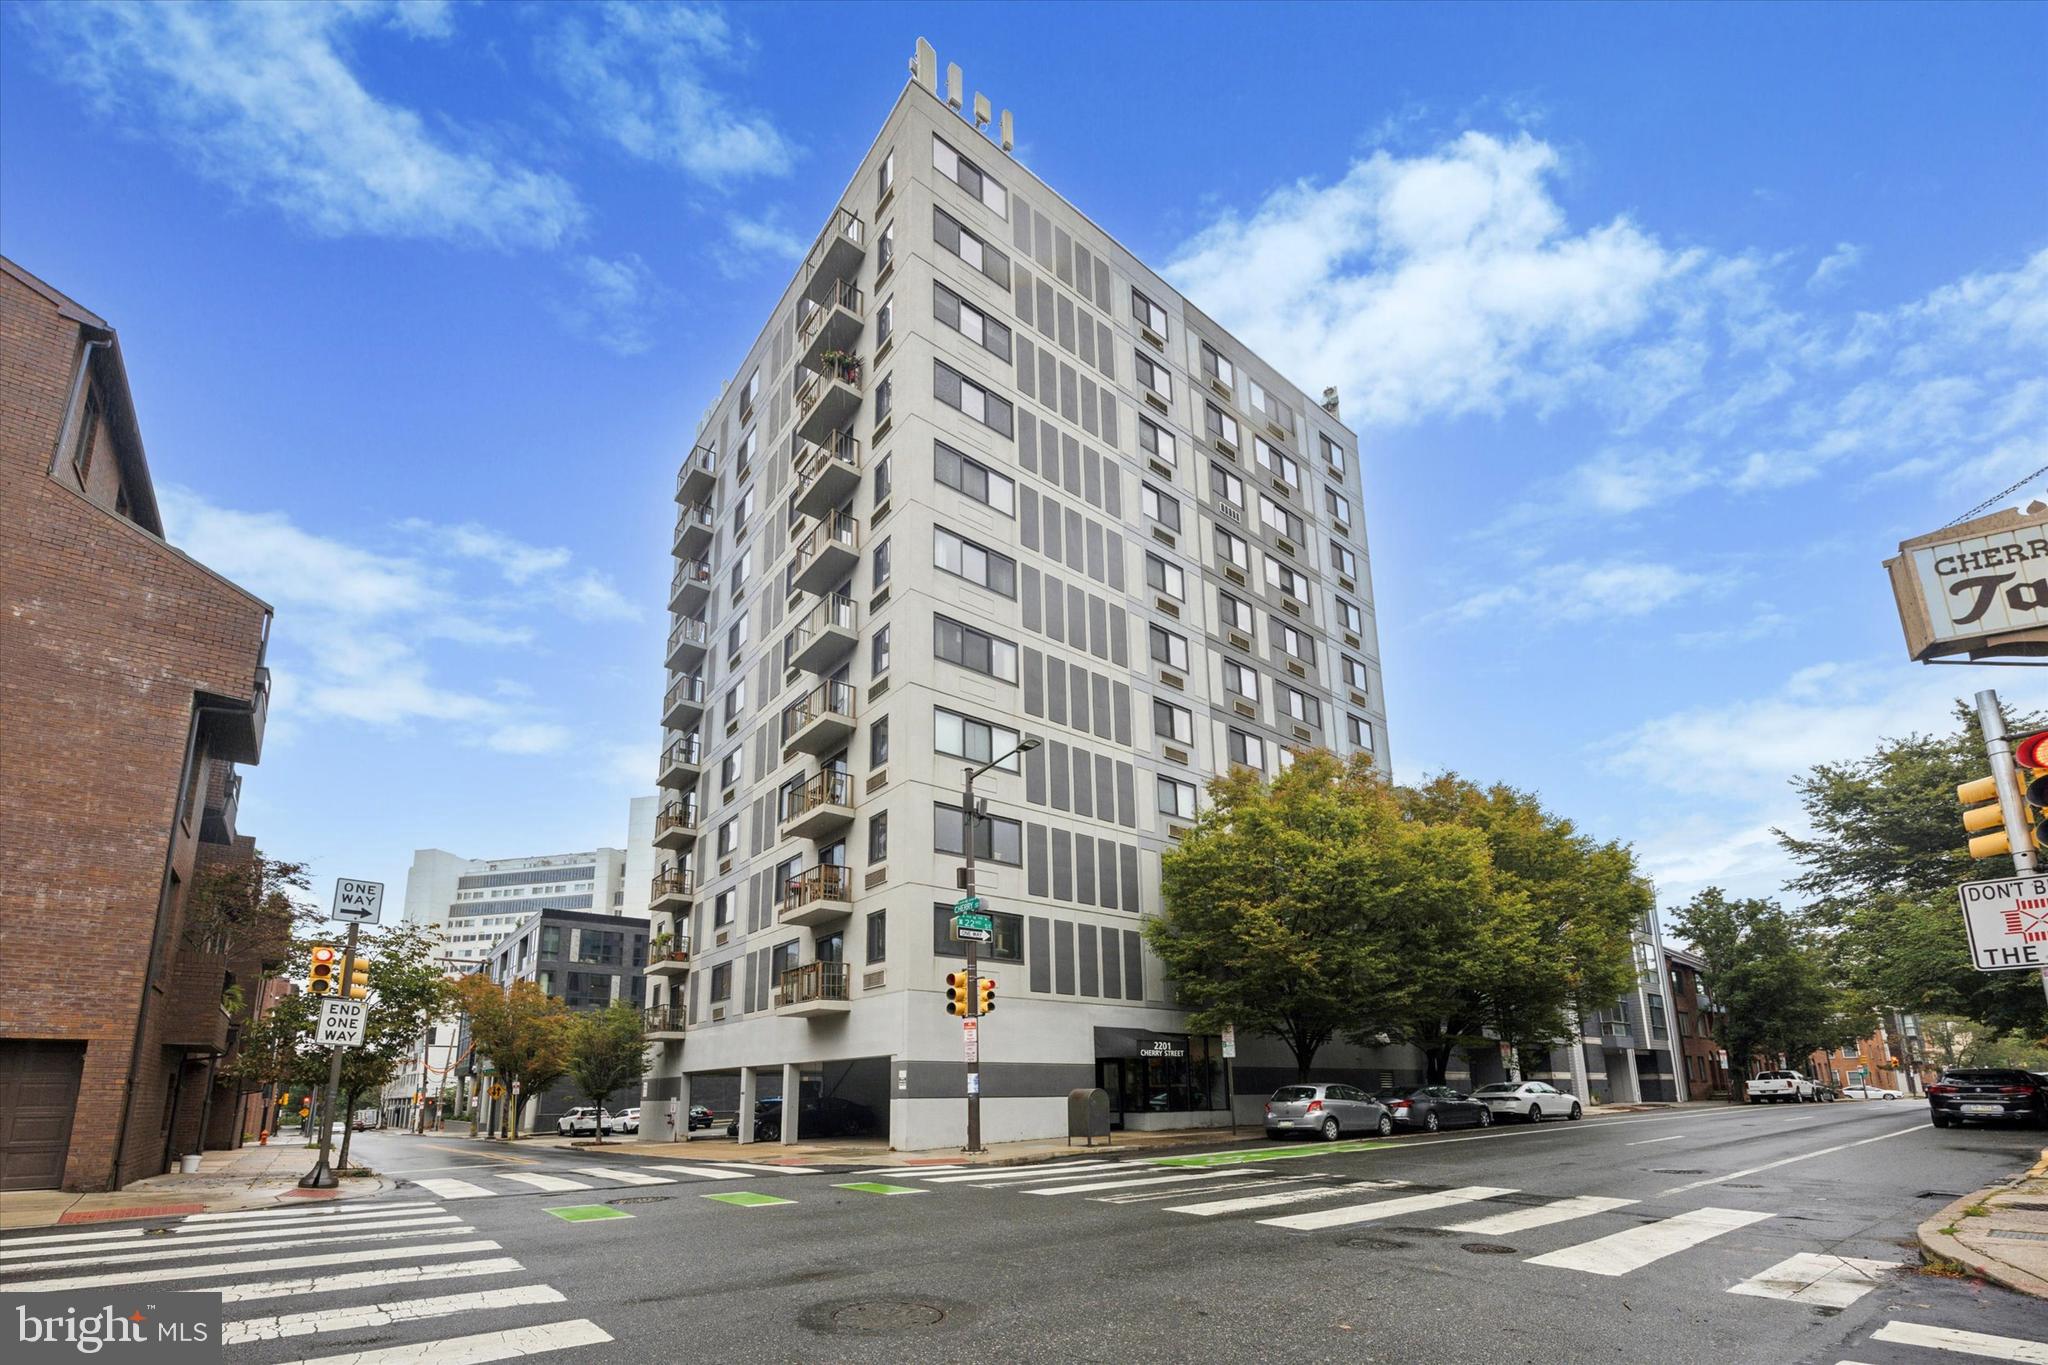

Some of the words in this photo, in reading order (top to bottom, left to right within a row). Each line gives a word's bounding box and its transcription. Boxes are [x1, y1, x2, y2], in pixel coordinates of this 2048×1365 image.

[1934, 538, 2048, 576] CHERR
[1949, 571, 2048, 625] Ta
[344, 882, 376, 895] ONE
[1968, 882, 2023, 902] DON'T
[2033, 879, 2048, 895] B
[342, 893, 375, 906] WAY
[954, 902, 974, 913] CHERRY
[1983, 945, 2039, 965] THE
[330, 1004, 361, 1016] END
[326, 1017, 359, 1029] ONE
[325, 1030, 357, 1041] WAY
[1153, 1041, 1171, 1050] 2201
[1140, 1049, 1163, 1057] CHERRY
